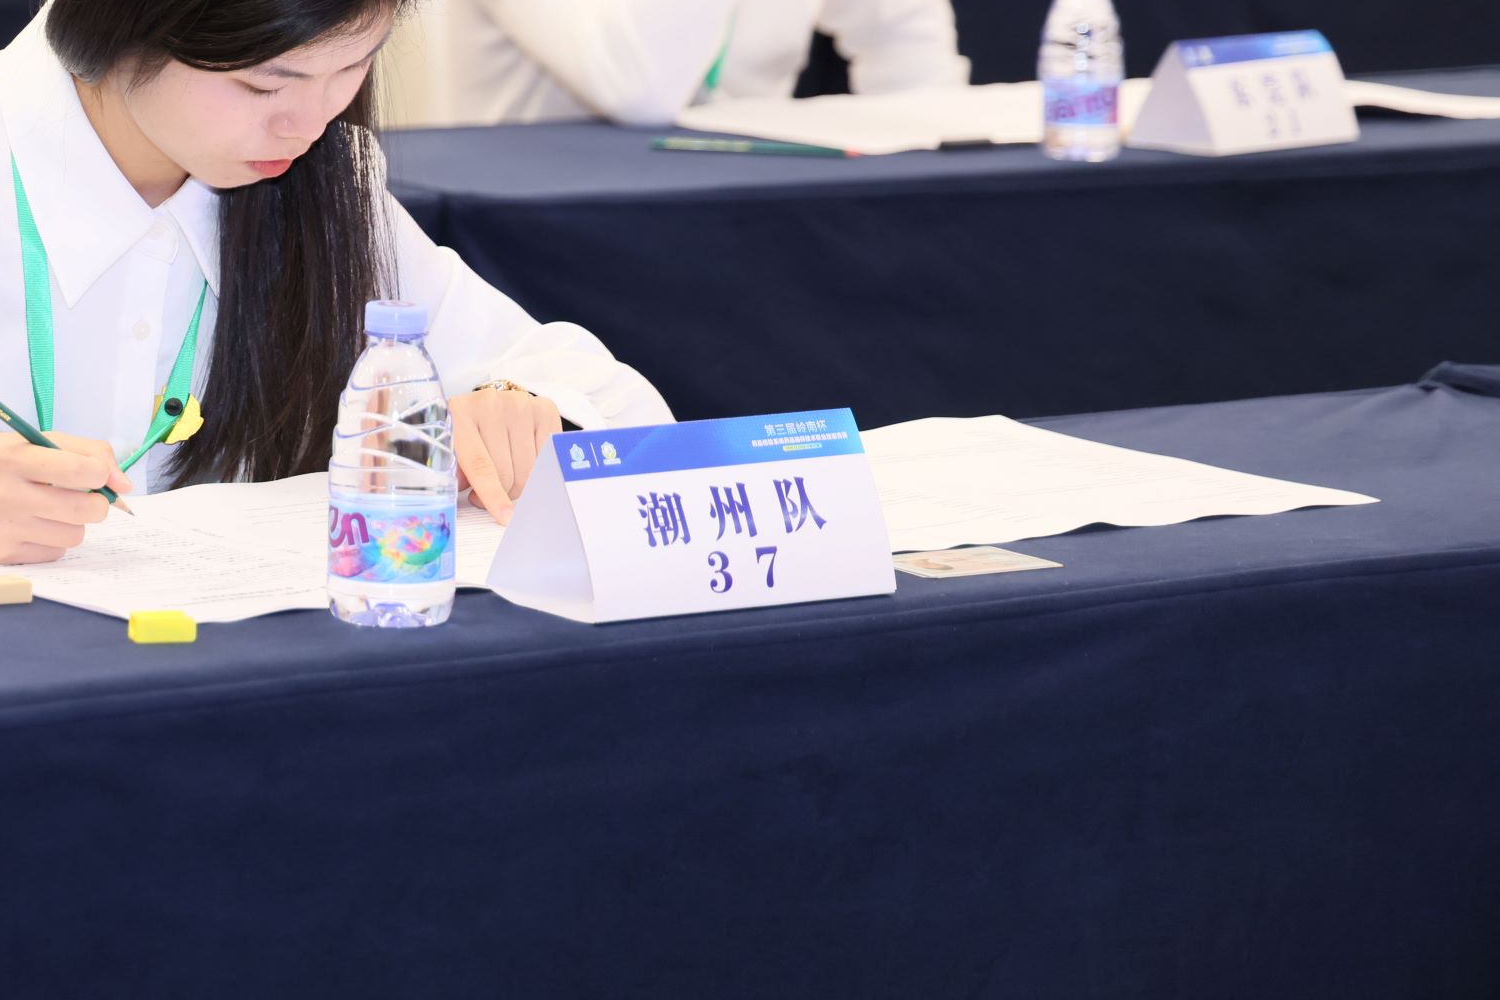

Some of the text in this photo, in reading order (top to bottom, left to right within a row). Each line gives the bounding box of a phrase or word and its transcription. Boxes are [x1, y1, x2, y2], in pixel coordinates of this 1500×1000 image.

[636, 476, 827, 548] 潮州队
[708, 546, 778, 593] 37
